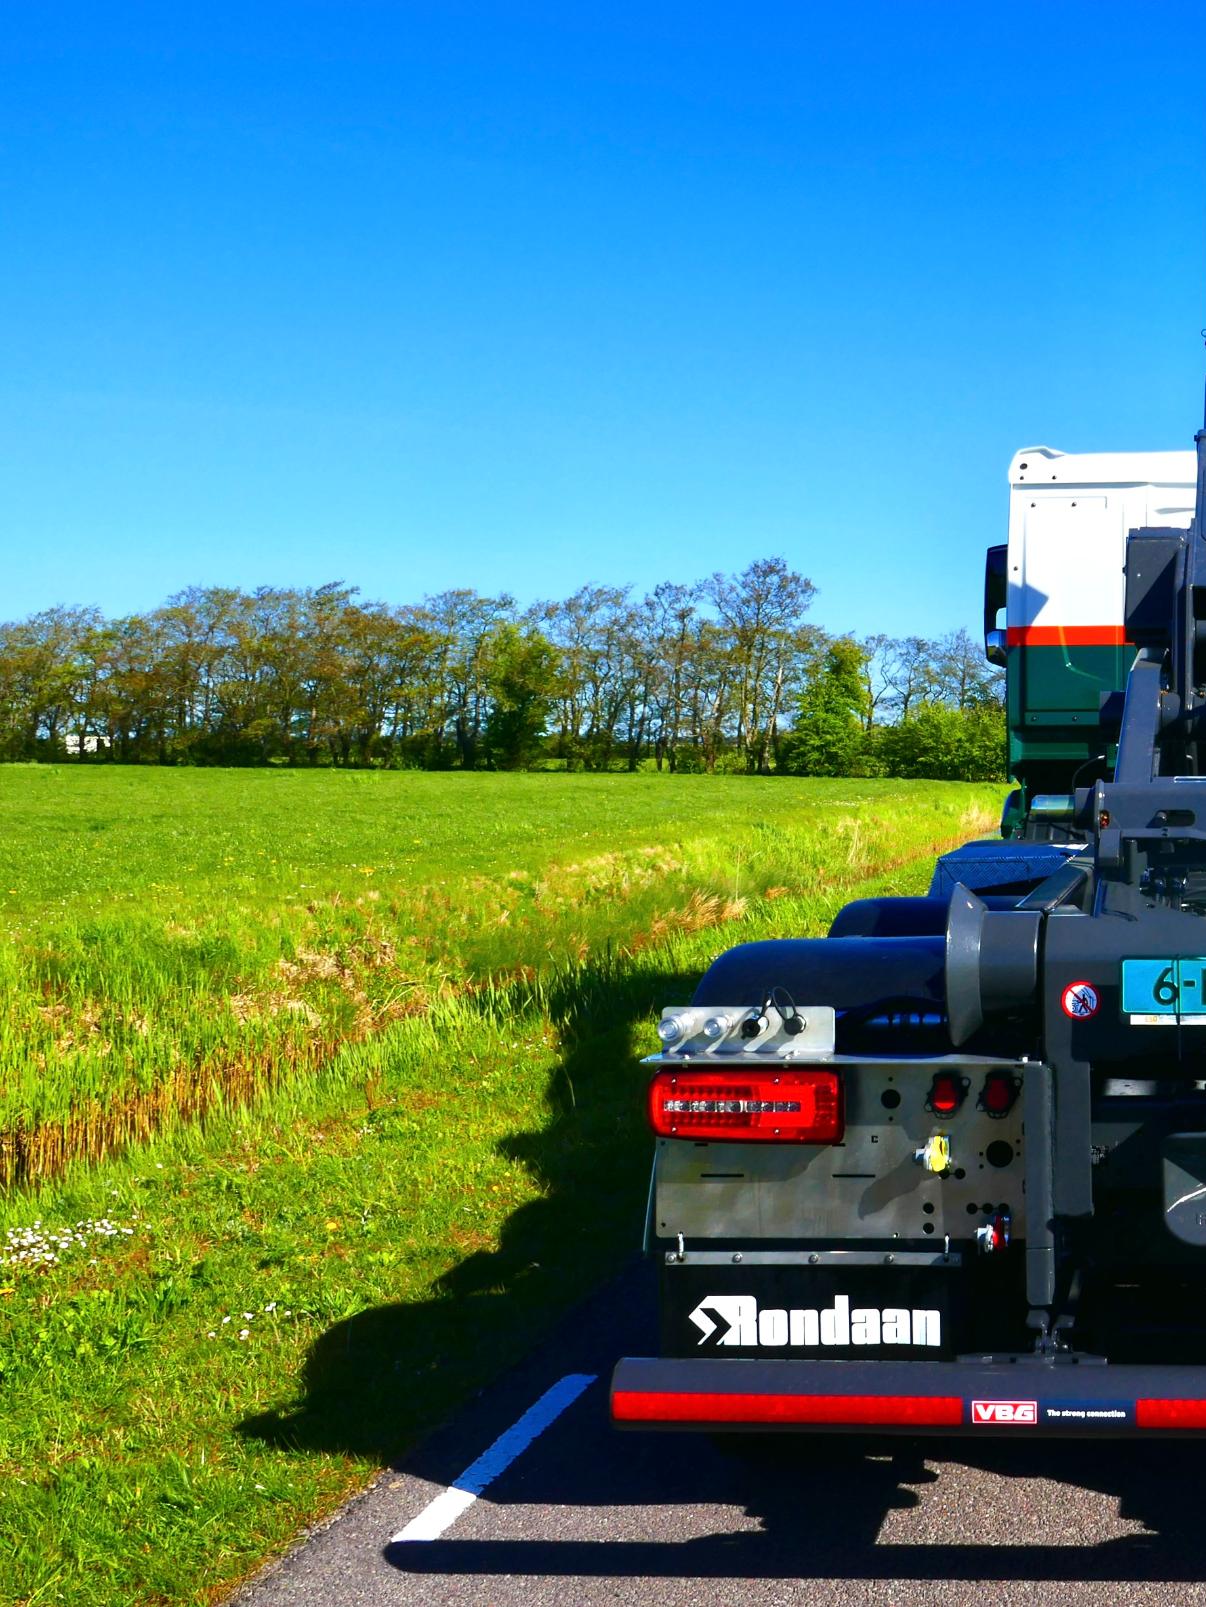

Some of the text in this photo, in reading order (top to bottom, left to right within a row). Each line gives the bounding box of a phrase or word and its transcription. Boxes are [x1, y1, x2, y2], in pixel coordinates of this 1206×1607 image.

[688, 1294, 941, 1347] Rondaan
[975, 1404, 1034, 1421] VBG
[1047, 1409, 1126, 1418] The strong connection
